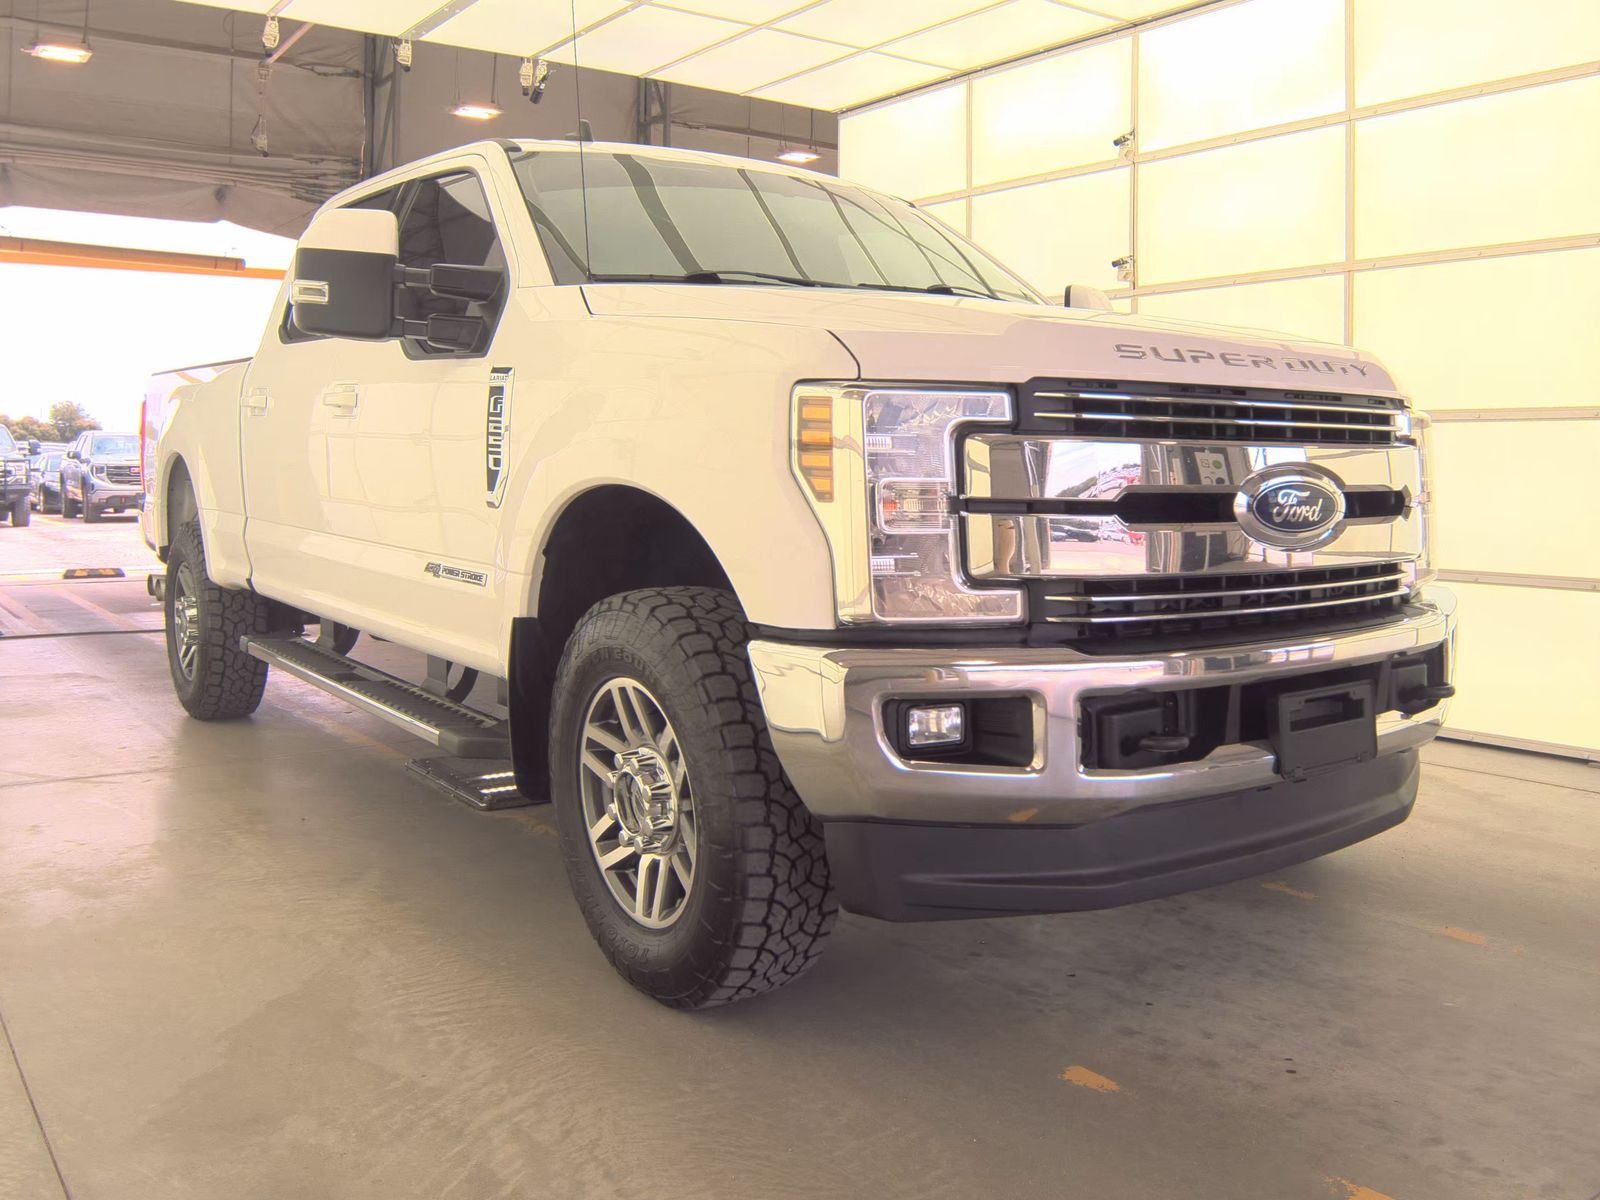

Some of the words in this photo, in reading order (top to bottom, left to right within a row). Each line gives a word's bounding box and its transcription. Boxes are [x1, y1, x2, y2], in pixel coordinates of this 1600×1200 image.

[1113, 343, 1277, 370] SUPER
[1281, 357, 1368, 377] DUTY
[1272, 489, 1323, 523] Ford
